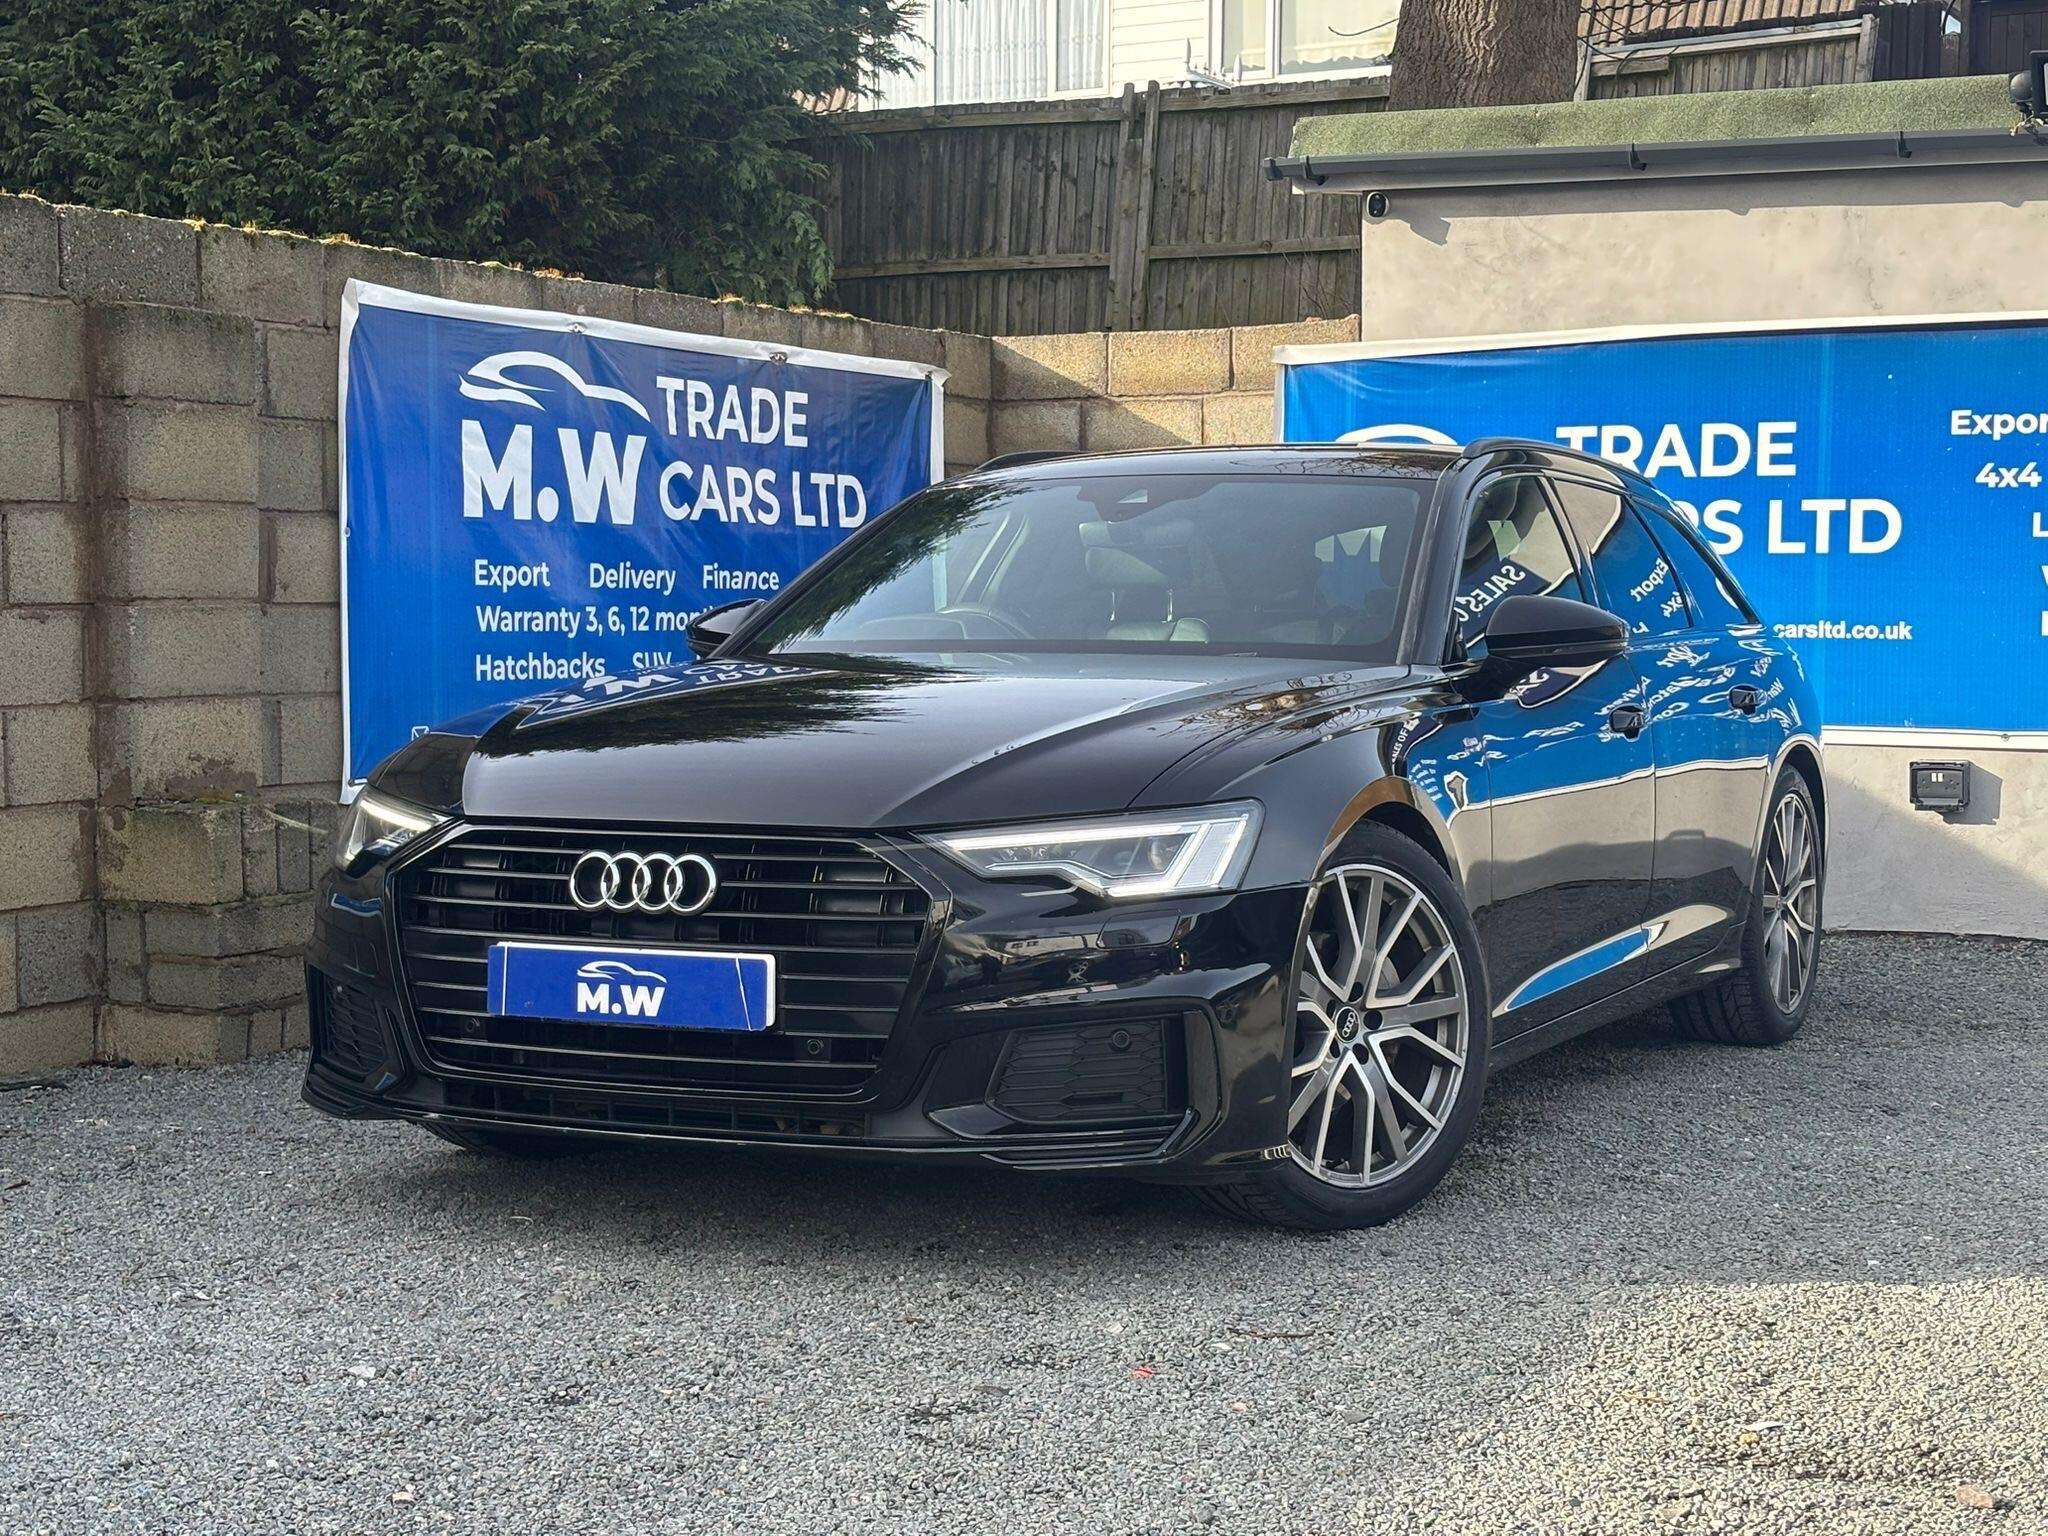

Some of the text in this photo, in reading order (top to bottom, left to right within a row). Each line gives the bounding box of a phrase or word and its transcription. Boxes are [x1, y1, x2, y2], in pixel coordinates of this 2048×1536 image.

[656, 374, 809, 449] TRADE
[460, 419, 647, 526] M.W
[1555, 421, 1797, 478] TRADE
[658, 459, 868, 528] CARS LTD
[1974, 461, 2043, 489] 4x4
[1767, 498, 1902, 554] LTD
[474, 559, 780, 596] Export Delivery Finance
[475, 605, 581, 639] Warranty
[585, 606, 603, 636] 3,
[607, 607, 625, 636] 6,
[630, 607, 650, 632] 12
[475, 652, 606, 681] Hatchbacks
[576, 981, 666, 1017] M.W
